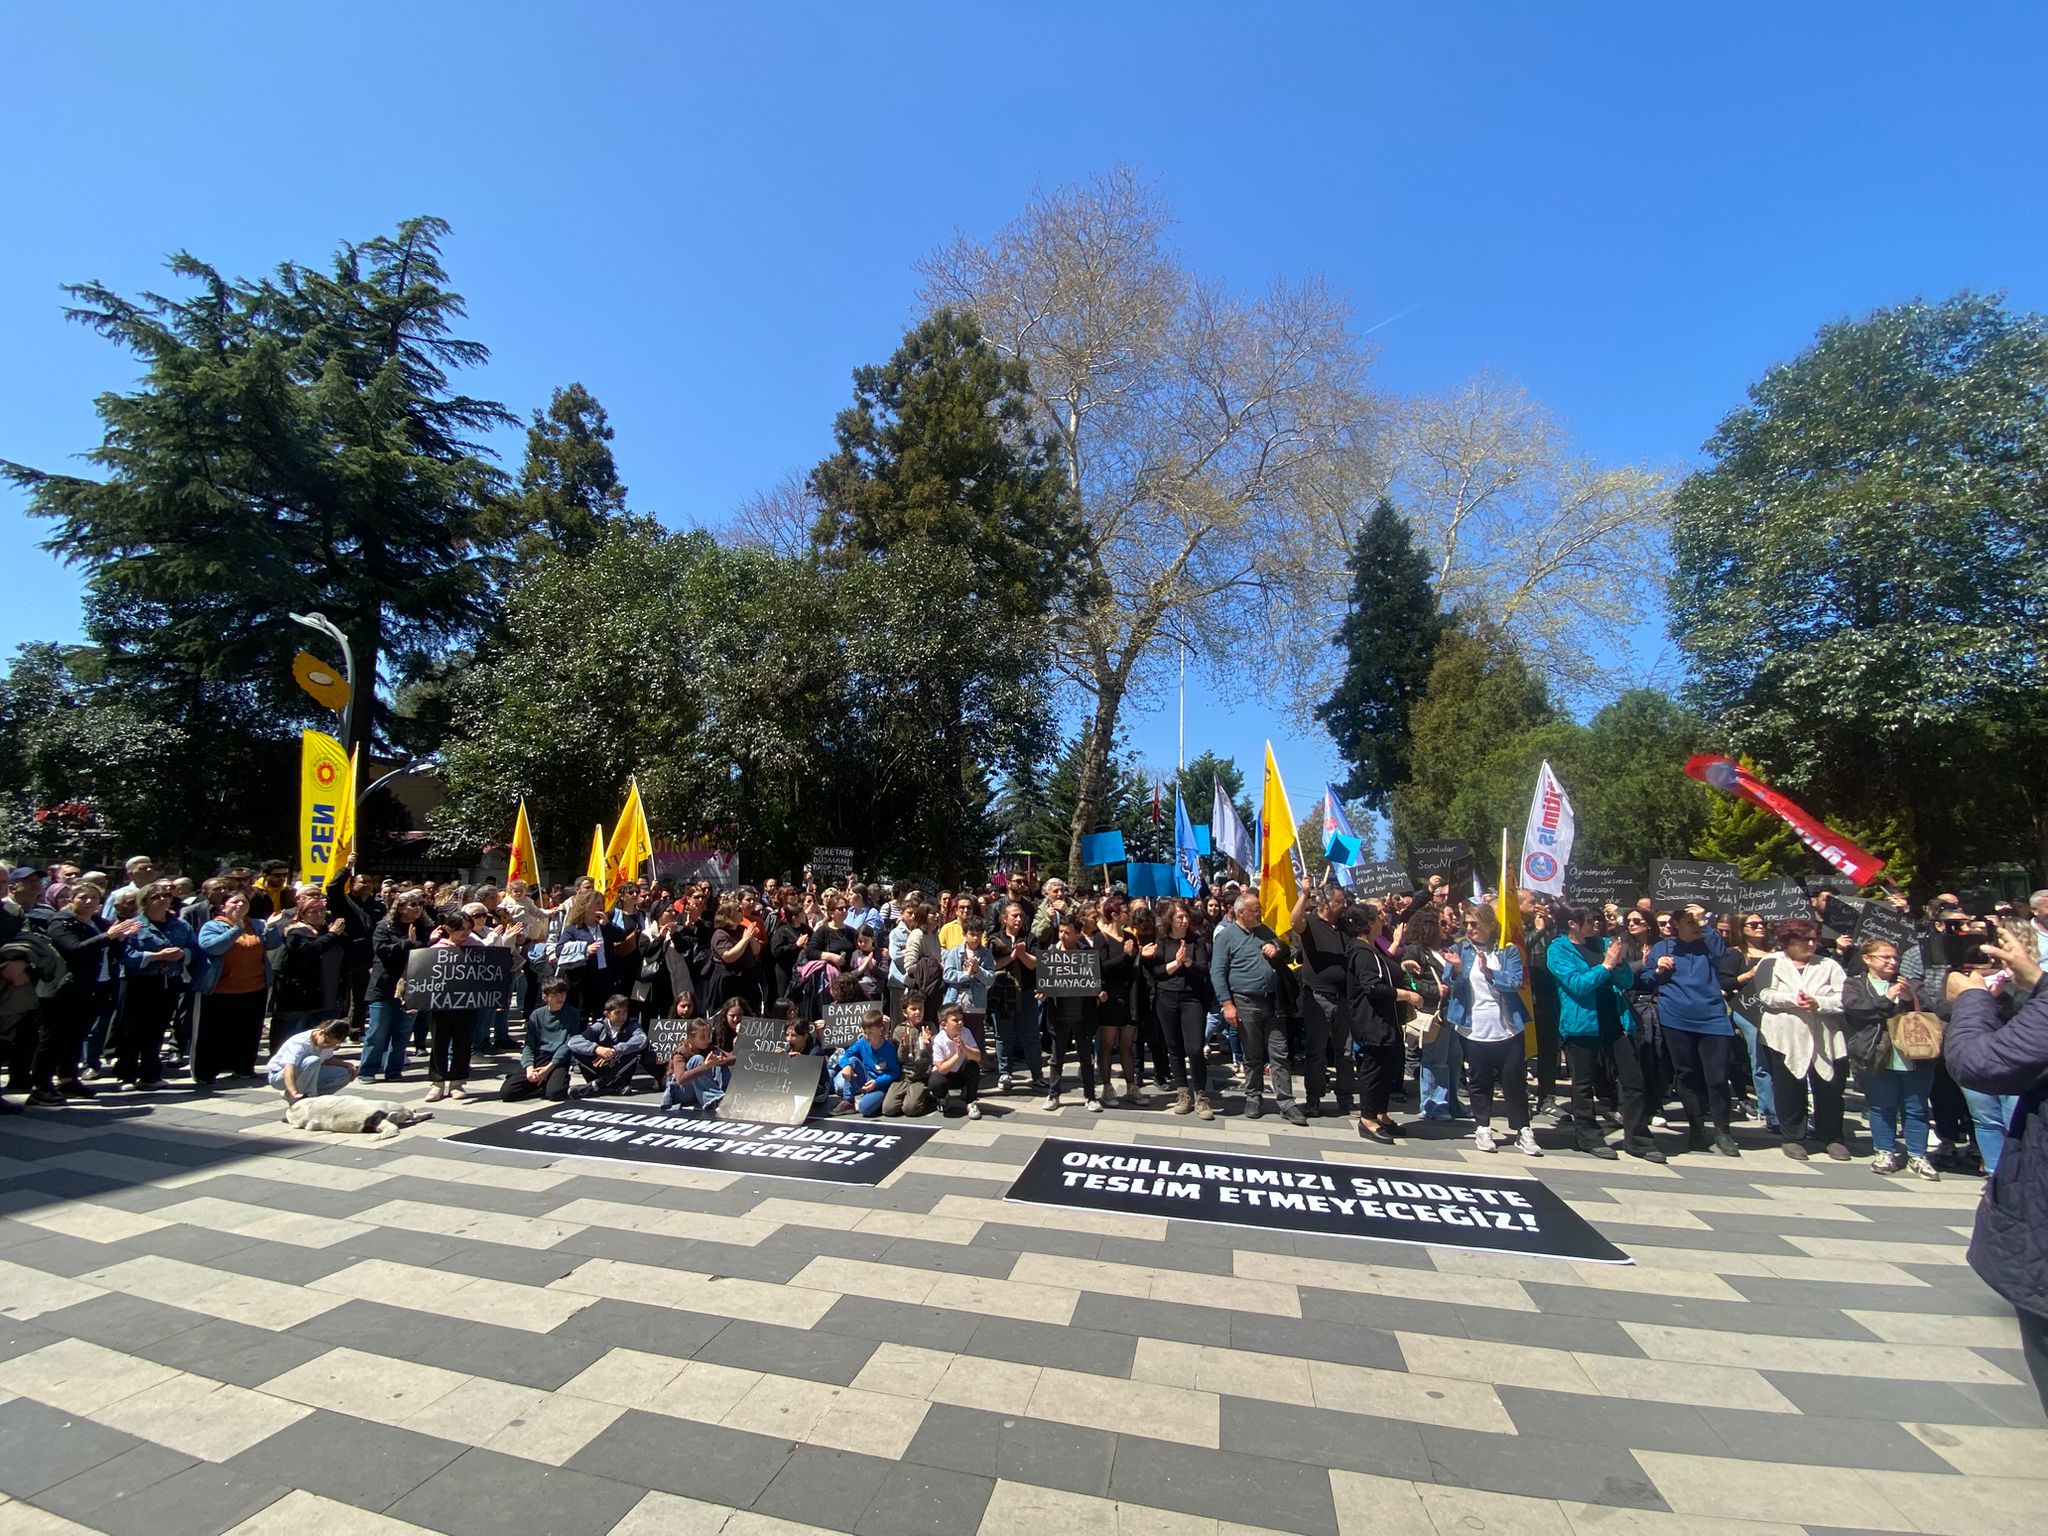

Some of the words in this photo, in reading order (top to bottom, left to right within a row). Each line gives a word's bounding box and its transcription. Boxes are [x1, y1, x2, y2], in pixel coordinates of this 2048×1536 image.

[1412, 843, 1458, 854] Sorumlular
[437, 949, 459, 963] Bir
[464, 948, 486, 964] Kişi
[1041, 951, 1096, 964] ŞİDDETE
[431, 965, 503, 981] SUSARSA
[1047, 964, 1093, 977] TESLİM
[430, 992, 503, 1009] KAZANIR
[828, 1004, 871, 1016] BAKAN
[740, 1020, 775, 1039] SUSMA
[551, 1108, 763, 1138] OKULLARIMIZI
[757, 1124, 902, 1149] ŞİDDETE
[516, 1120, 629, 1144] TESLİM
[633, 1126, 876, 1167] ETMEYECEĞİZ!
[1062, 1151, 1336, 1192] OKULLARIMIZI
[1350, 1175, 1534, 1209] ŞİDDETE
[1062, 1171, 1201, 1200] TESLİM
[1219, 1187, 1543, 1233] ETMEYECEĞİZ!
